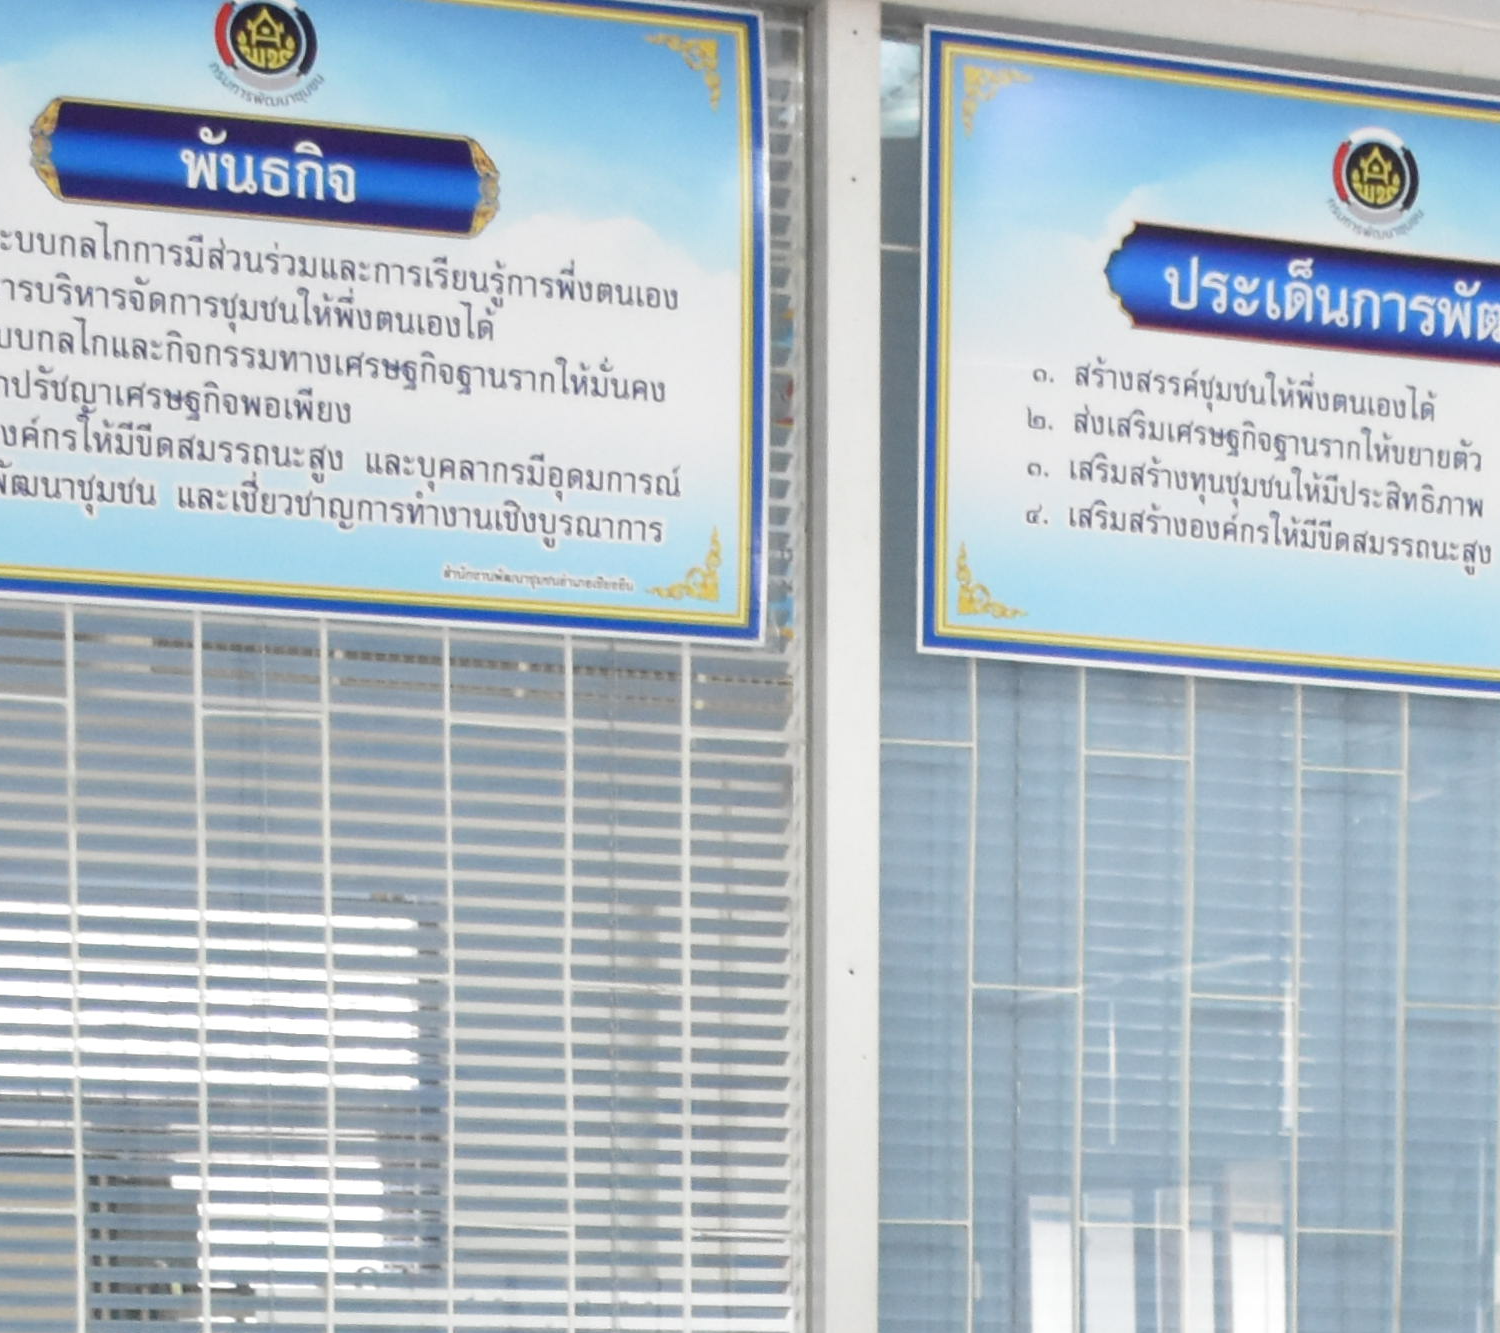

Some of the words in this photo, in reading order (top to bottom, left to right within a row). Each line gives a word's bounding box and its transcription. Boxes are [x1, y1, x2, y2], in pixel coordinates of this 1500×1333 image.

[208, 60, 326, 108] กรมการพัฒนาชุมชน
[180, 127, 358, 206] พันธกิจ
[1074, 356, 1436, 423] สร้างสรรค์ชุมชนให้พึ่งตนเองได้
[1073, 405, 1483, 473] ส่งเสริมเศรษฐกิจฐานรากให้ขยายตัว
[365, 449, 682, 502] และบุคลากรมีอุดมการณ์
[1069, 451, 1485, 520] เสริมสร้างทุนชุมชนให้มีประสิทธิภาพ
[177, 471, 664, 549] และเชี่ยวชาญการทำงานเชิงบูรณาการ
[1068, 498, 1492, 575] เสริมสร้างองค์กรให้มีขีดสมรรถนะสูง
